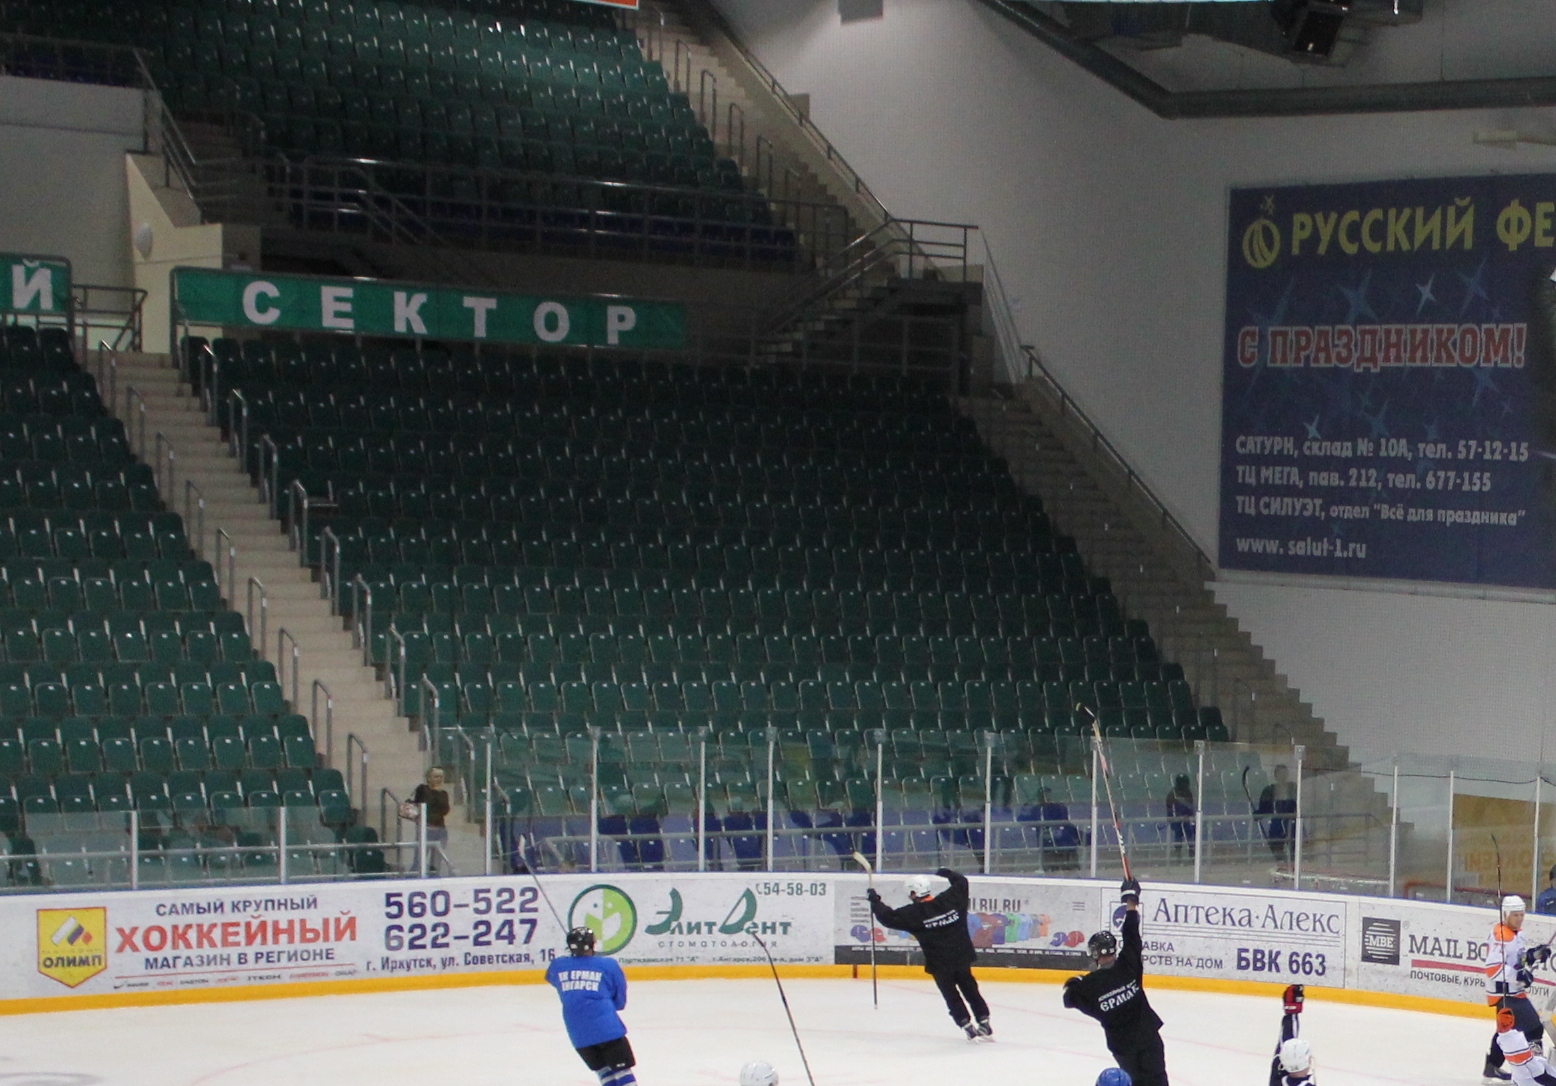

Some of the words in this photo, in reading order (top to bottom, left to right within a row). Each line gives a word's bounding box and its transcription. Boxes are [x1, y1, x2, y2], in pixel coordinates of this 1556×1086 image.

[1291, 197, 1475, 255] РУССКИЙ
[242, 279, 638, 347] СЕКТОР
[1238, 324, 1259, 366] С
[1268, 322, 1528, 372] ПРАЗДНИКОМ!
[1236, 435, 1299, 460] САТУРН,
[1303, 438, 1354, 459] склад
[1356, 437, 1375, 458] №
[1417, 441, 1453, 460] тел.
[1457, 439, 1530, 463] 57-12-15
[1236, 465, 1256, 487] ТЦ
[1260, 465, 1304, 489] МЕГА,
[1308, 469, 1344, 488] пав.
[1348, 468, 1383, 490] 212,
[1387, 471, 1421, 490] тел.
[1426, 470, 1492, 493] 677-155
[1236, 496, 1256, 518] ТЦ
[1259, 496, 1325, 521] СИЛУЭТ,
[1330, 504, 1371, 520] отдел
[1236, 538, 1285, 555] www.
[1288, 536, 1367, 559] salut-1.ru
[384, 886, 540, 921] 560-522
[762, 881, 828, 899] 54-58-03
[155, 898, 226, 918] САМЫЙ
[230, 895, 319, 914] КРУПНЫЙ
[1260, 903, 1341, 935] Алекс
[115, 909, 358, 954] ХОККЕЙНЫЙ
[383, 917, 540, 952] 622-247
[144, 951, 232, 972] МАГАЗИН
[237, 950, 249, 966] В
[254, 947, 336, 965] РЕГИОНЕ
[1408, 934, 1464, 960] MAIL
[43, 952, 103, 970] ОЛИМП
[380, 954, 438, 974] Иркутск,
[441, 953, 460, 972] ул.
[463, 948, 537, 970] Советская,
[1176, 956, 1194, 967] НА
[1196, 958, 1224, 970] ДОМ
[1236, 946, 1282, 974] БВК
[1288, 950, 1327, 977] 663
[1410, 969, 1462, 986] ПОЧТОВЫЕ,
